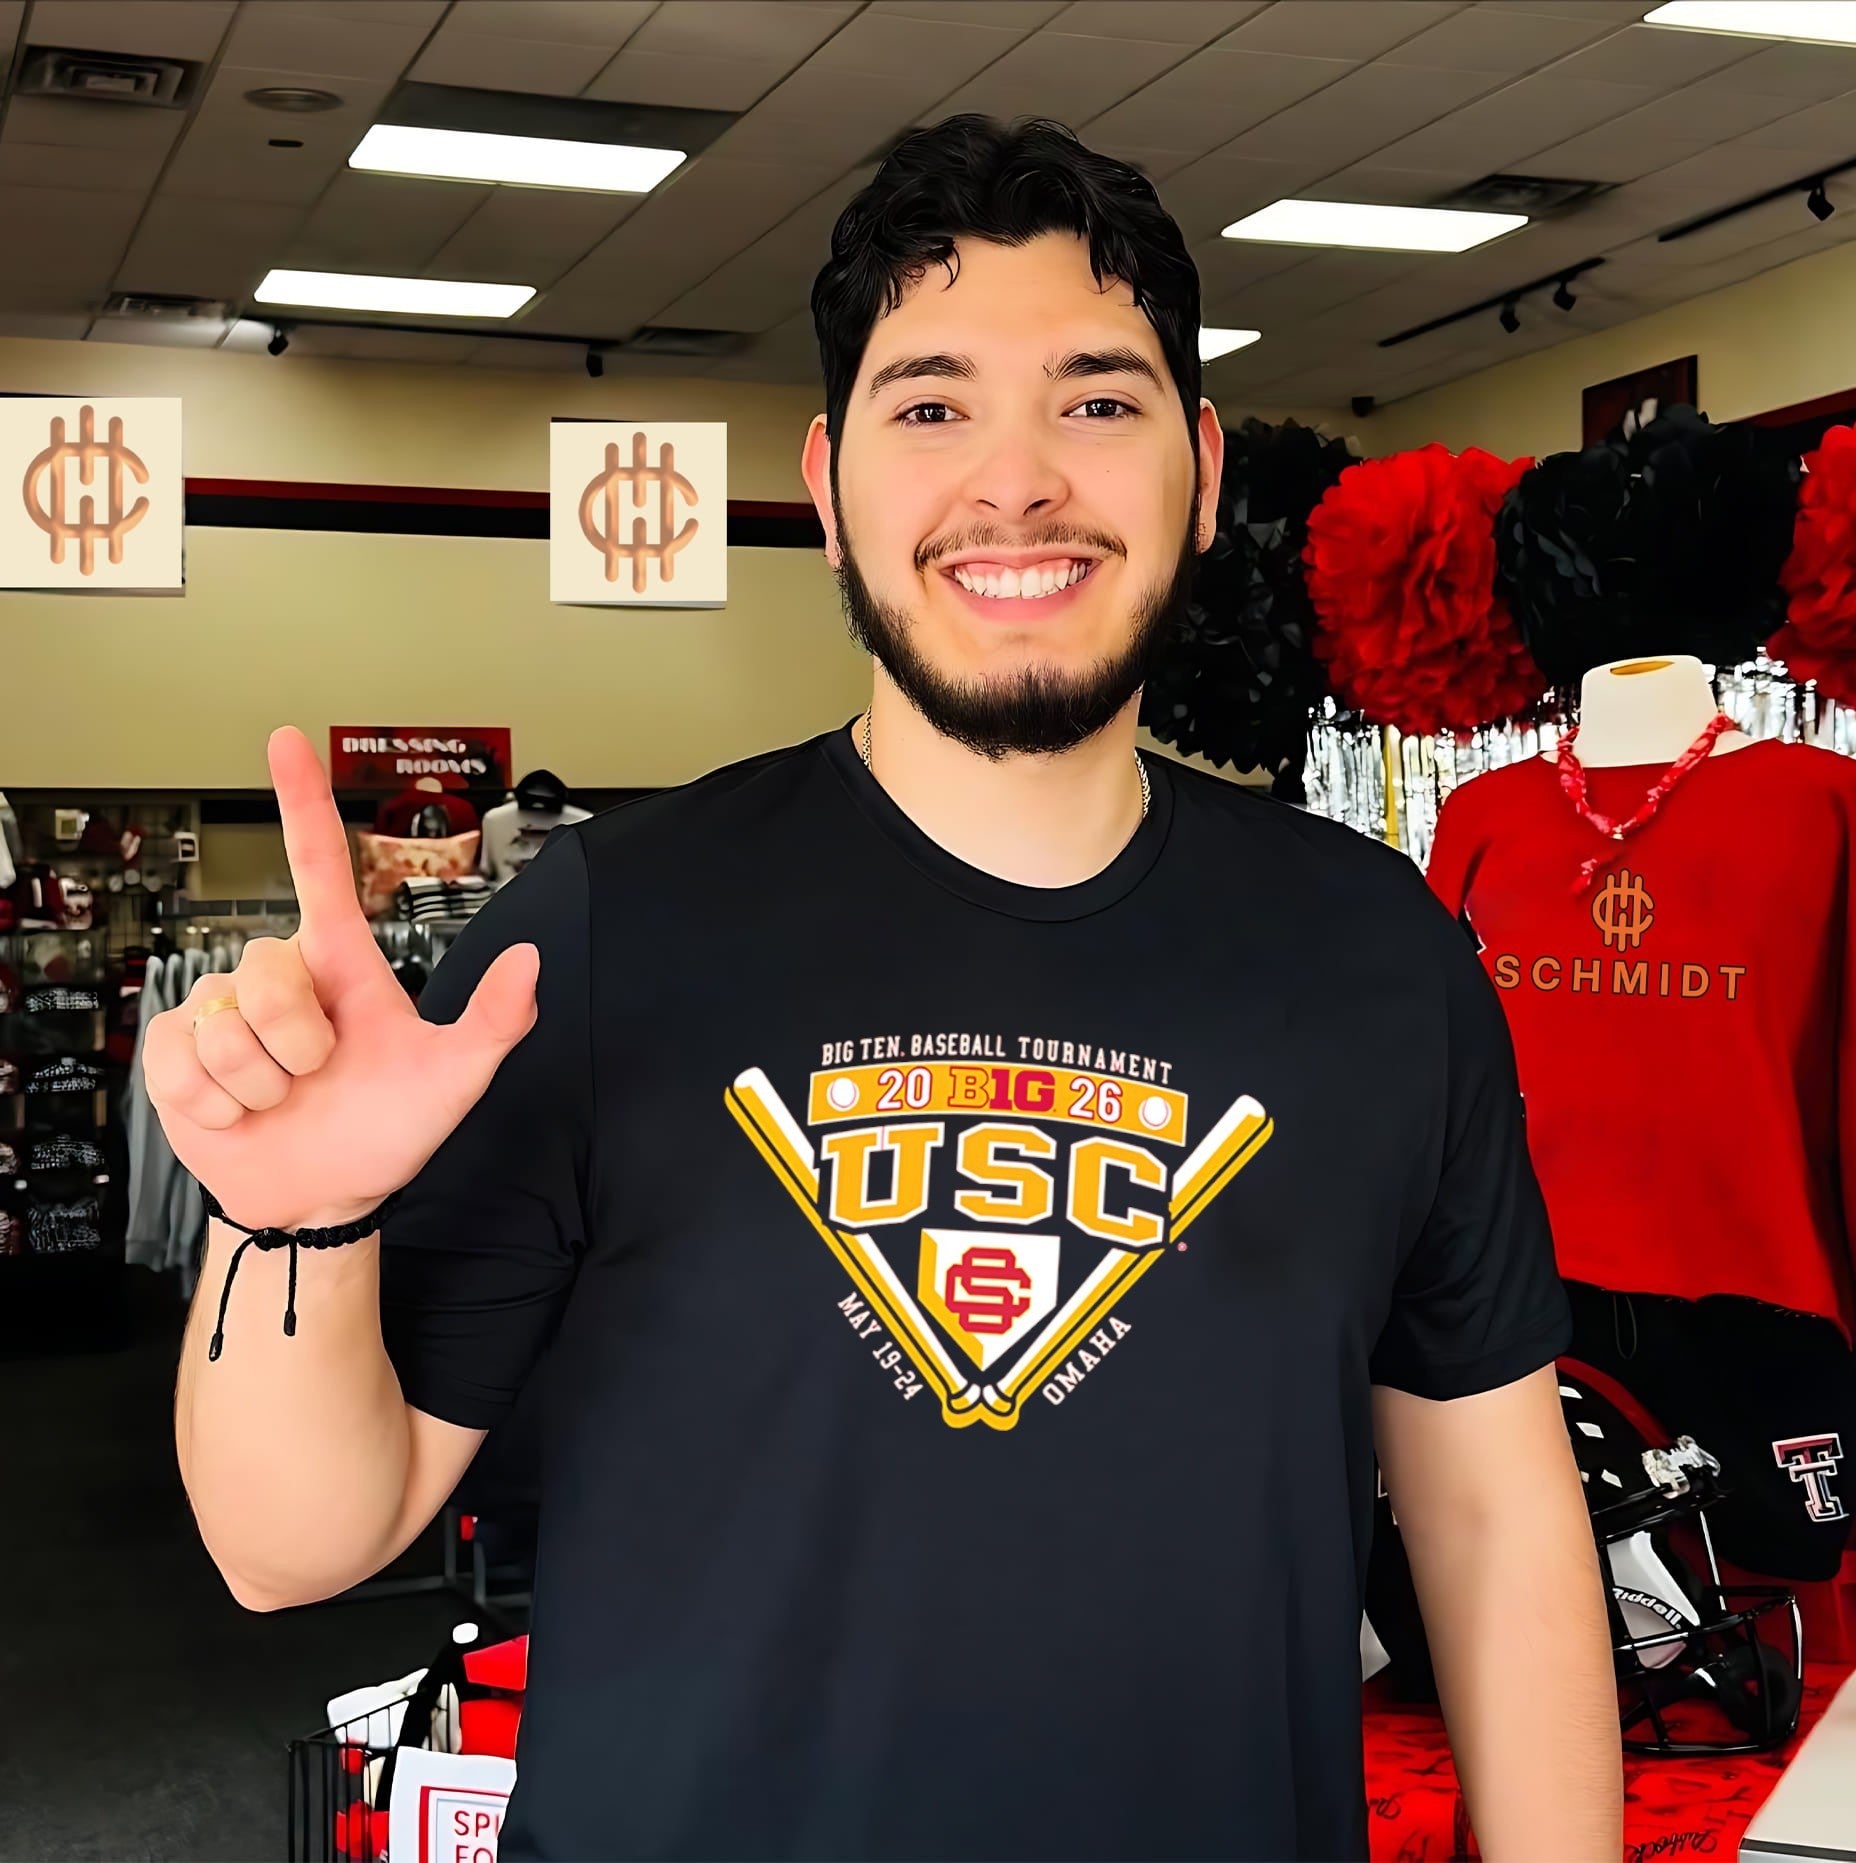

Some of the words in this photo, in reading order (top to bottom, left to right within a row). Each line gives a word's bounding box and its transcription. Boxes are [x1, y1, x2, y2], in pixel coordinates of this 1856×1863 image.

[342, 736, 467, 754] DRESSING
[396, 757, 487, 775] ROOMS
[1494, 954, 1747, 1000] SCHMIDT
[821, 1040, 854, 1066] BIG
[910, 1032, 1006, 1057] BASEBALL
[1017, 1036, 1173, 1085] TOURNAMENT
[876, 1067, 933, 1112] 20
[1067, 1075, 1124, 1124] 26
[820, 1121, 1168, 1248] USC
[837, 1291, 882, 1339] MAY
[872, 1341, 924, 1400] 19-24
[1042, 1316, 1132, 1405] OMAHA
